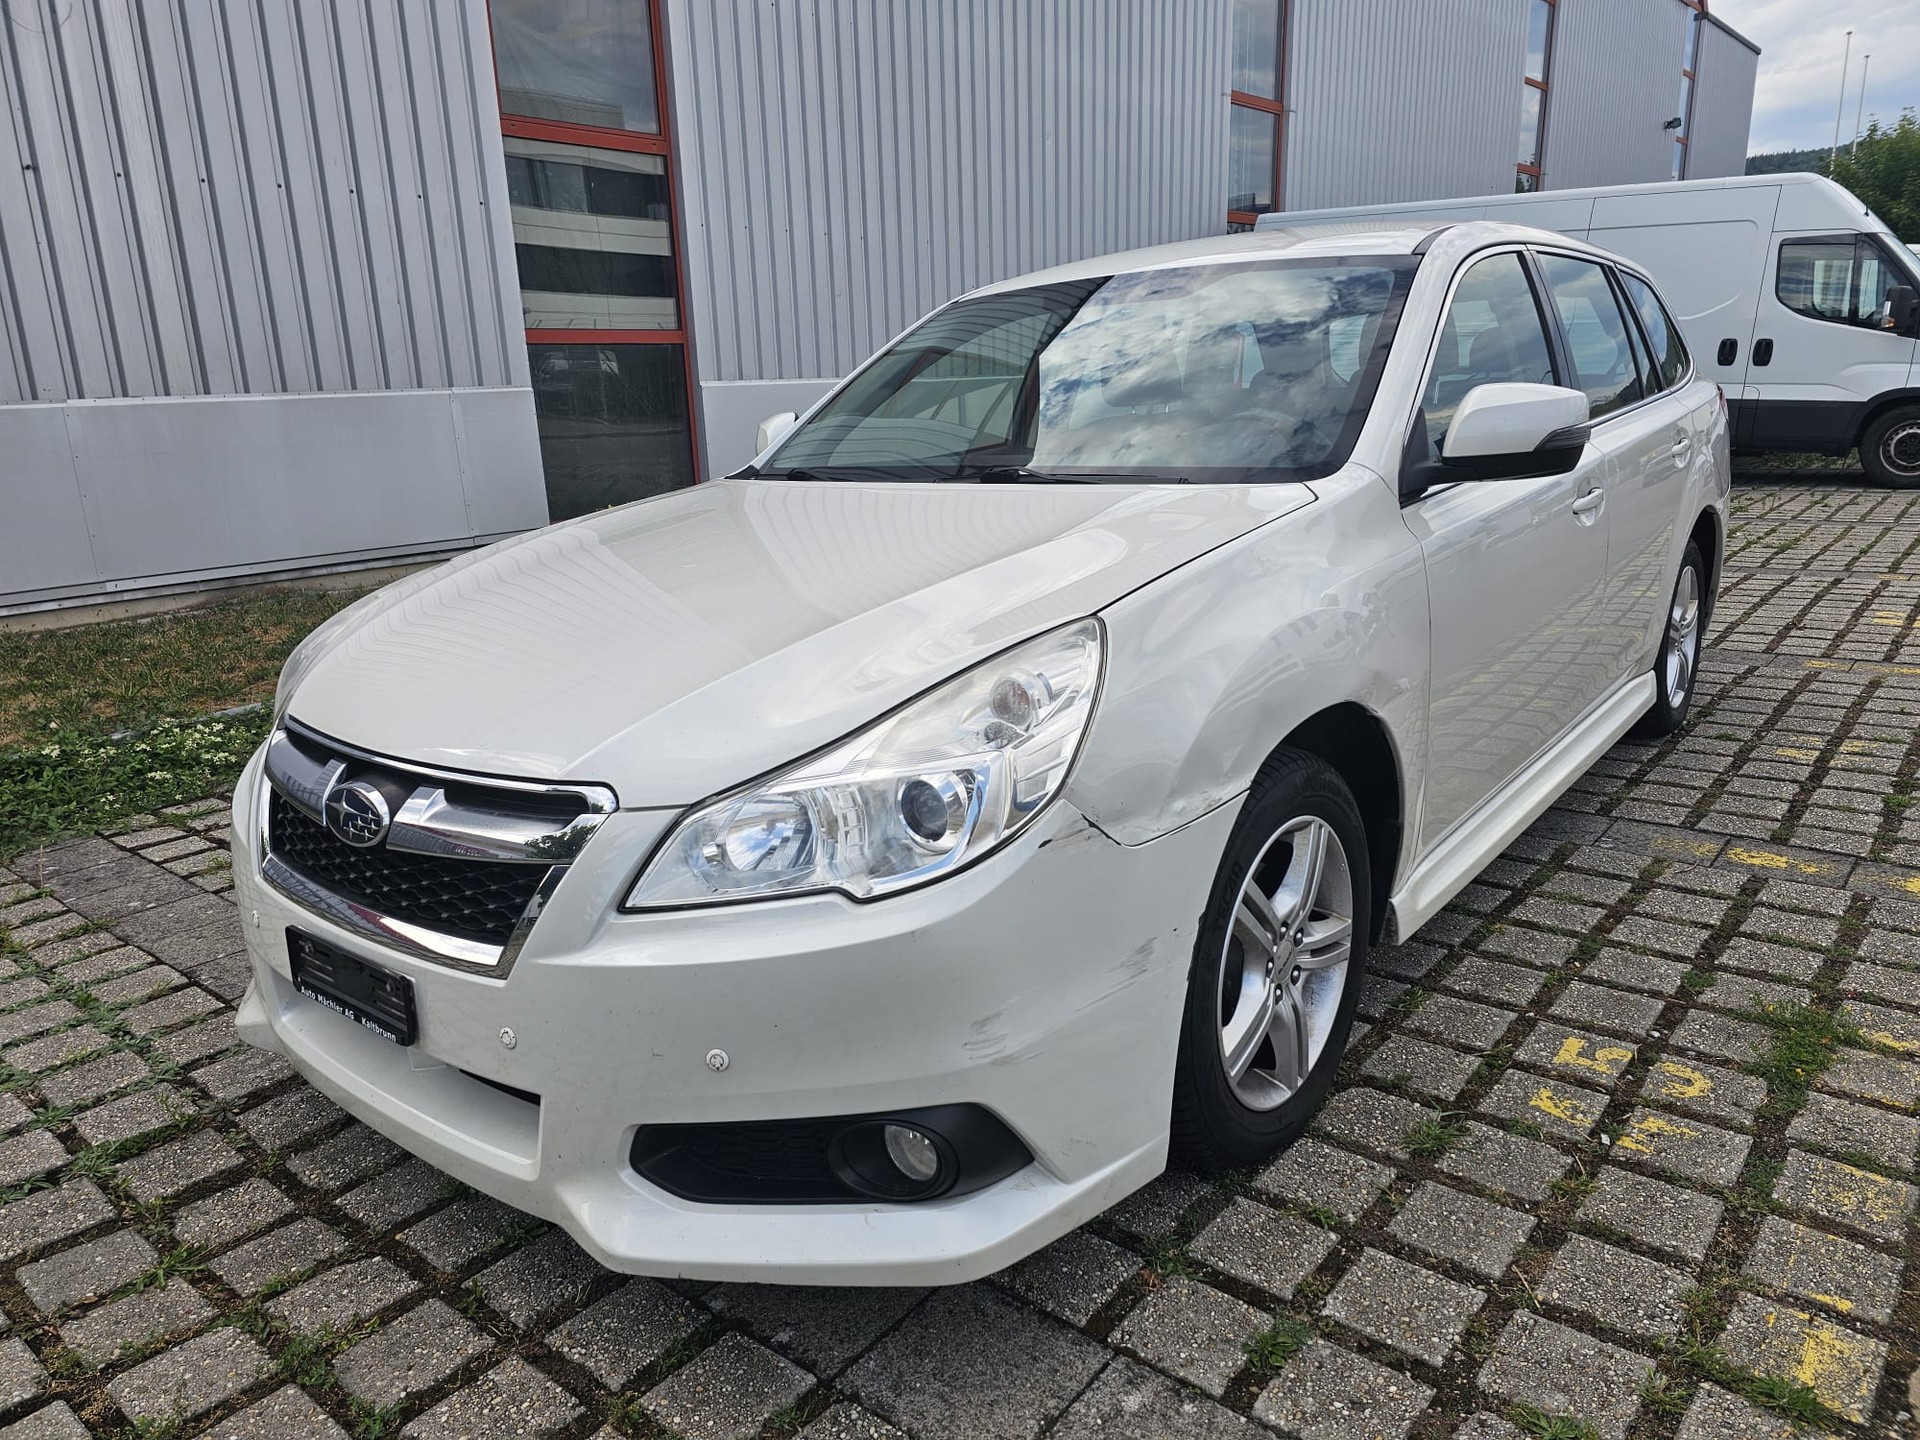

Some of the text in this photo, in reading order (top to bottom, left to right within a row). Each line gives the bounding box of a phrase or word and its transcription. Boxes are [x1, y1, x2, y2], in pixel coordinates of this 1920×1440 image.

[301, 985, 316, 999] Auto
[345, 1008, 355, 1020] AG
[361, 1016, 396, 1042] Kaltbrunn
